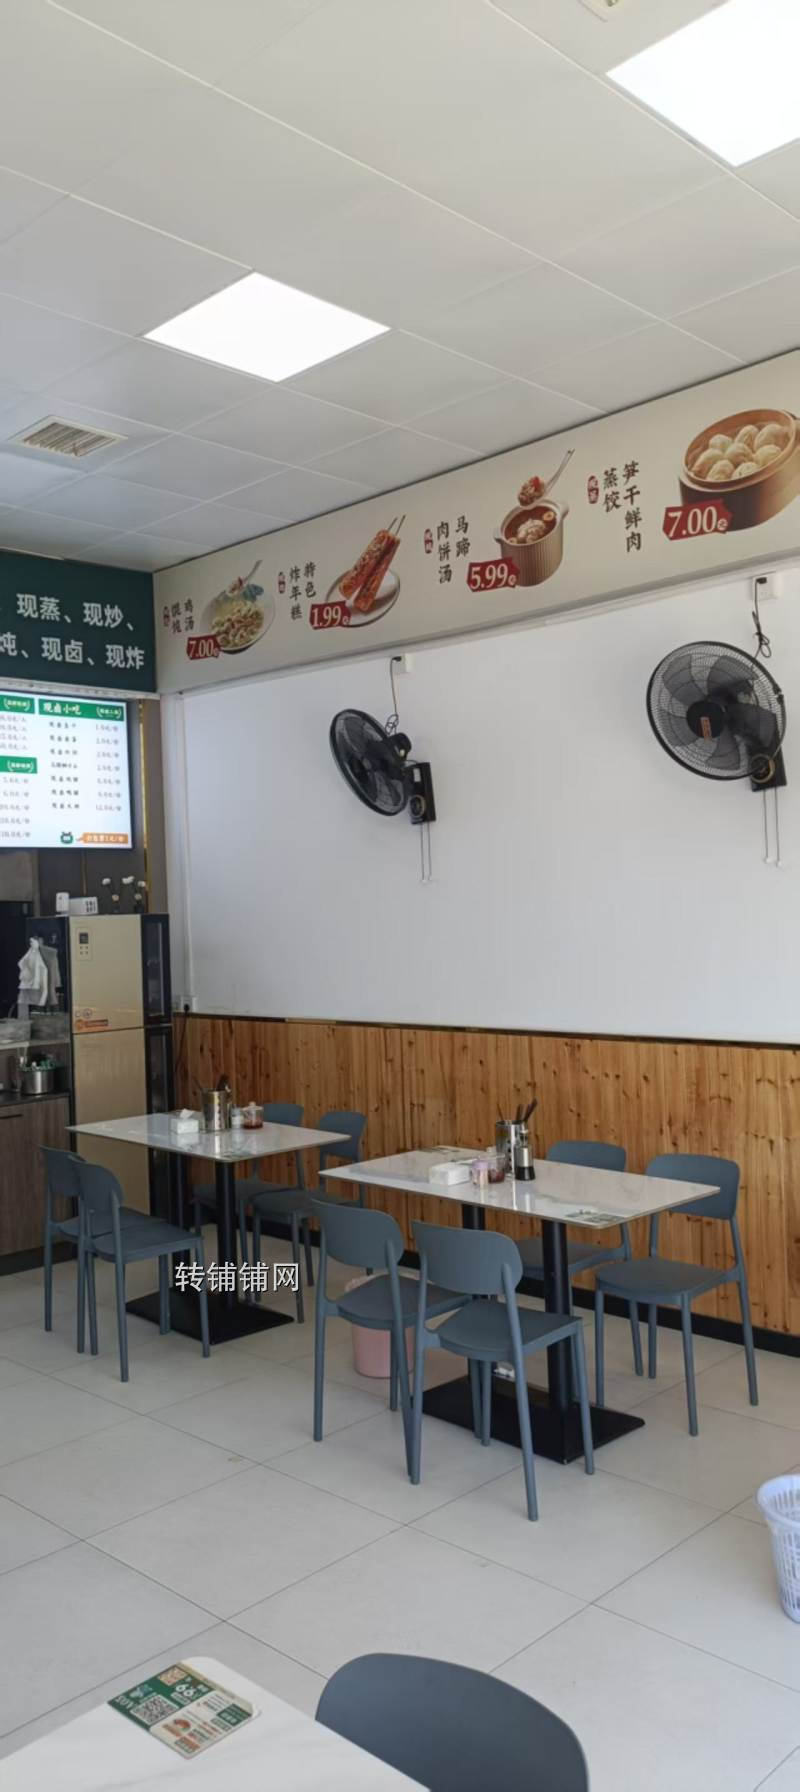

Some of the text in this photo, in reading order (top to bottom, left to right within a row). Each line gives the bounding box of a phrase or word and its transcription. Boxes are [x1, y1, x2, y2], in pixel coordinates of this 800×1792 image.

[603, 468, 621, 512] 蒸饺
[623, 461, 642, 552] 笋干鲜肉
[437, 521, 452, 584] 肉饼汤
[456, 515, 470, 557] 马蹄
[290, 566, 302, 620] 炸年糕
[304, 561, 316, 598] 特色
